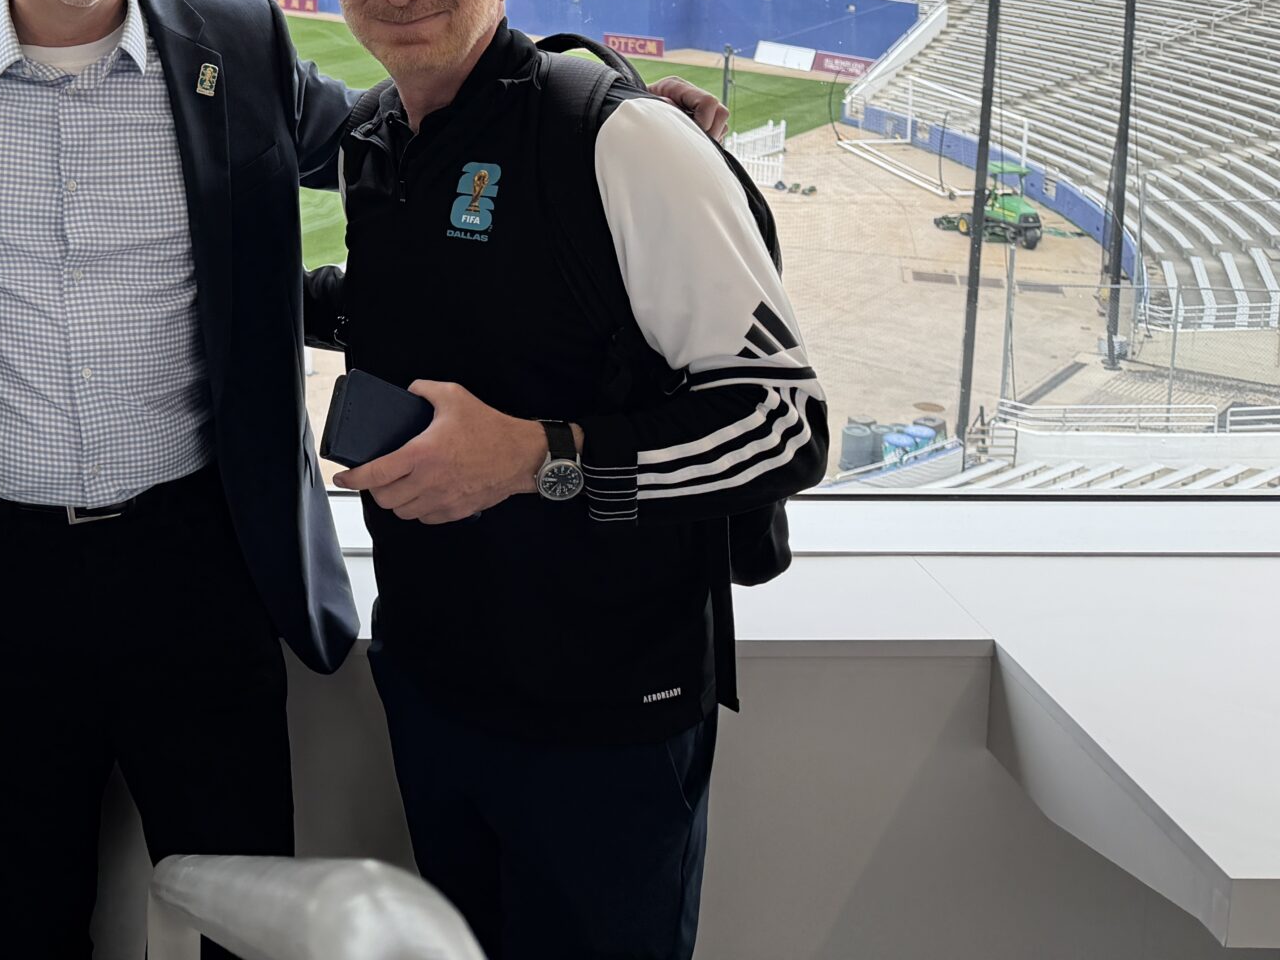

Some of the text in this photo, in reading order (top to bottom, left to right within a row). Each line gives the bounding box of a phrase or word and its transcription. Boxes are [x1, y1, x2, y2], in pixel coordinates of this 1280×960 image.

[461, 215, 480, 224] FIFA
[447, 230, 488, 241] DALLAS
[643, 688, 681, 703] AEROREADY
